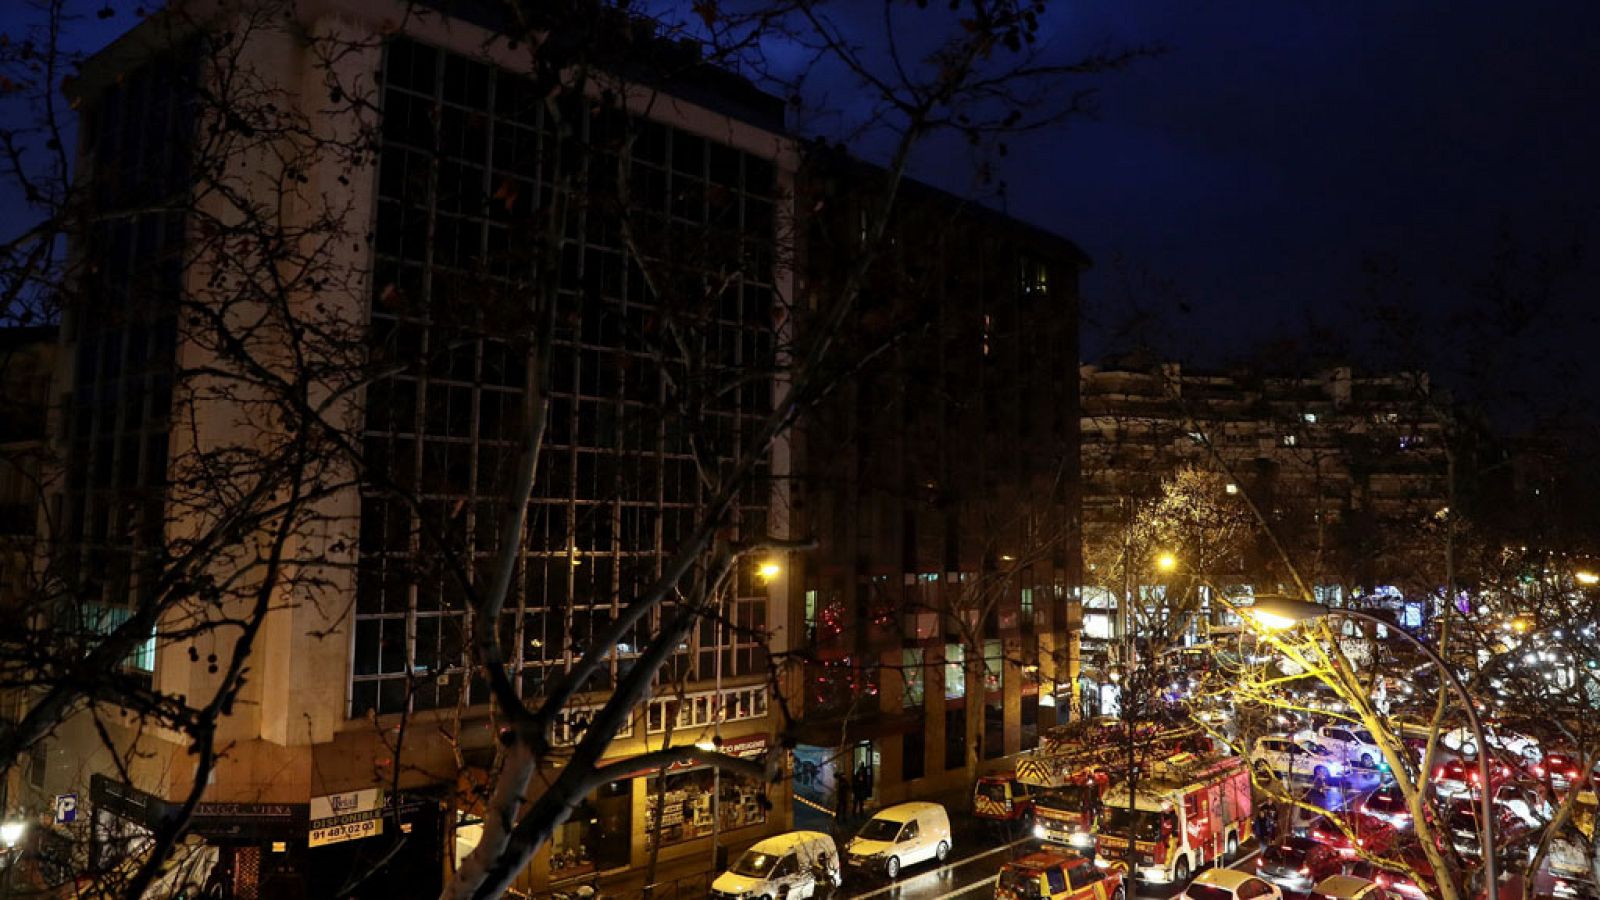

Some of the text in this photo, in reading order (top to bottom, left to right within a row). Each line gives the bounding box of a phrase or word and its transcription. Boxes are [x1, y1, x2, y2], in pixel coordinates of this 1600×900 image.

[58, 797, 76, 821] P
[312, 809, 383, 829] DISPONIBLE
[313, 830, 325, 840] 91
